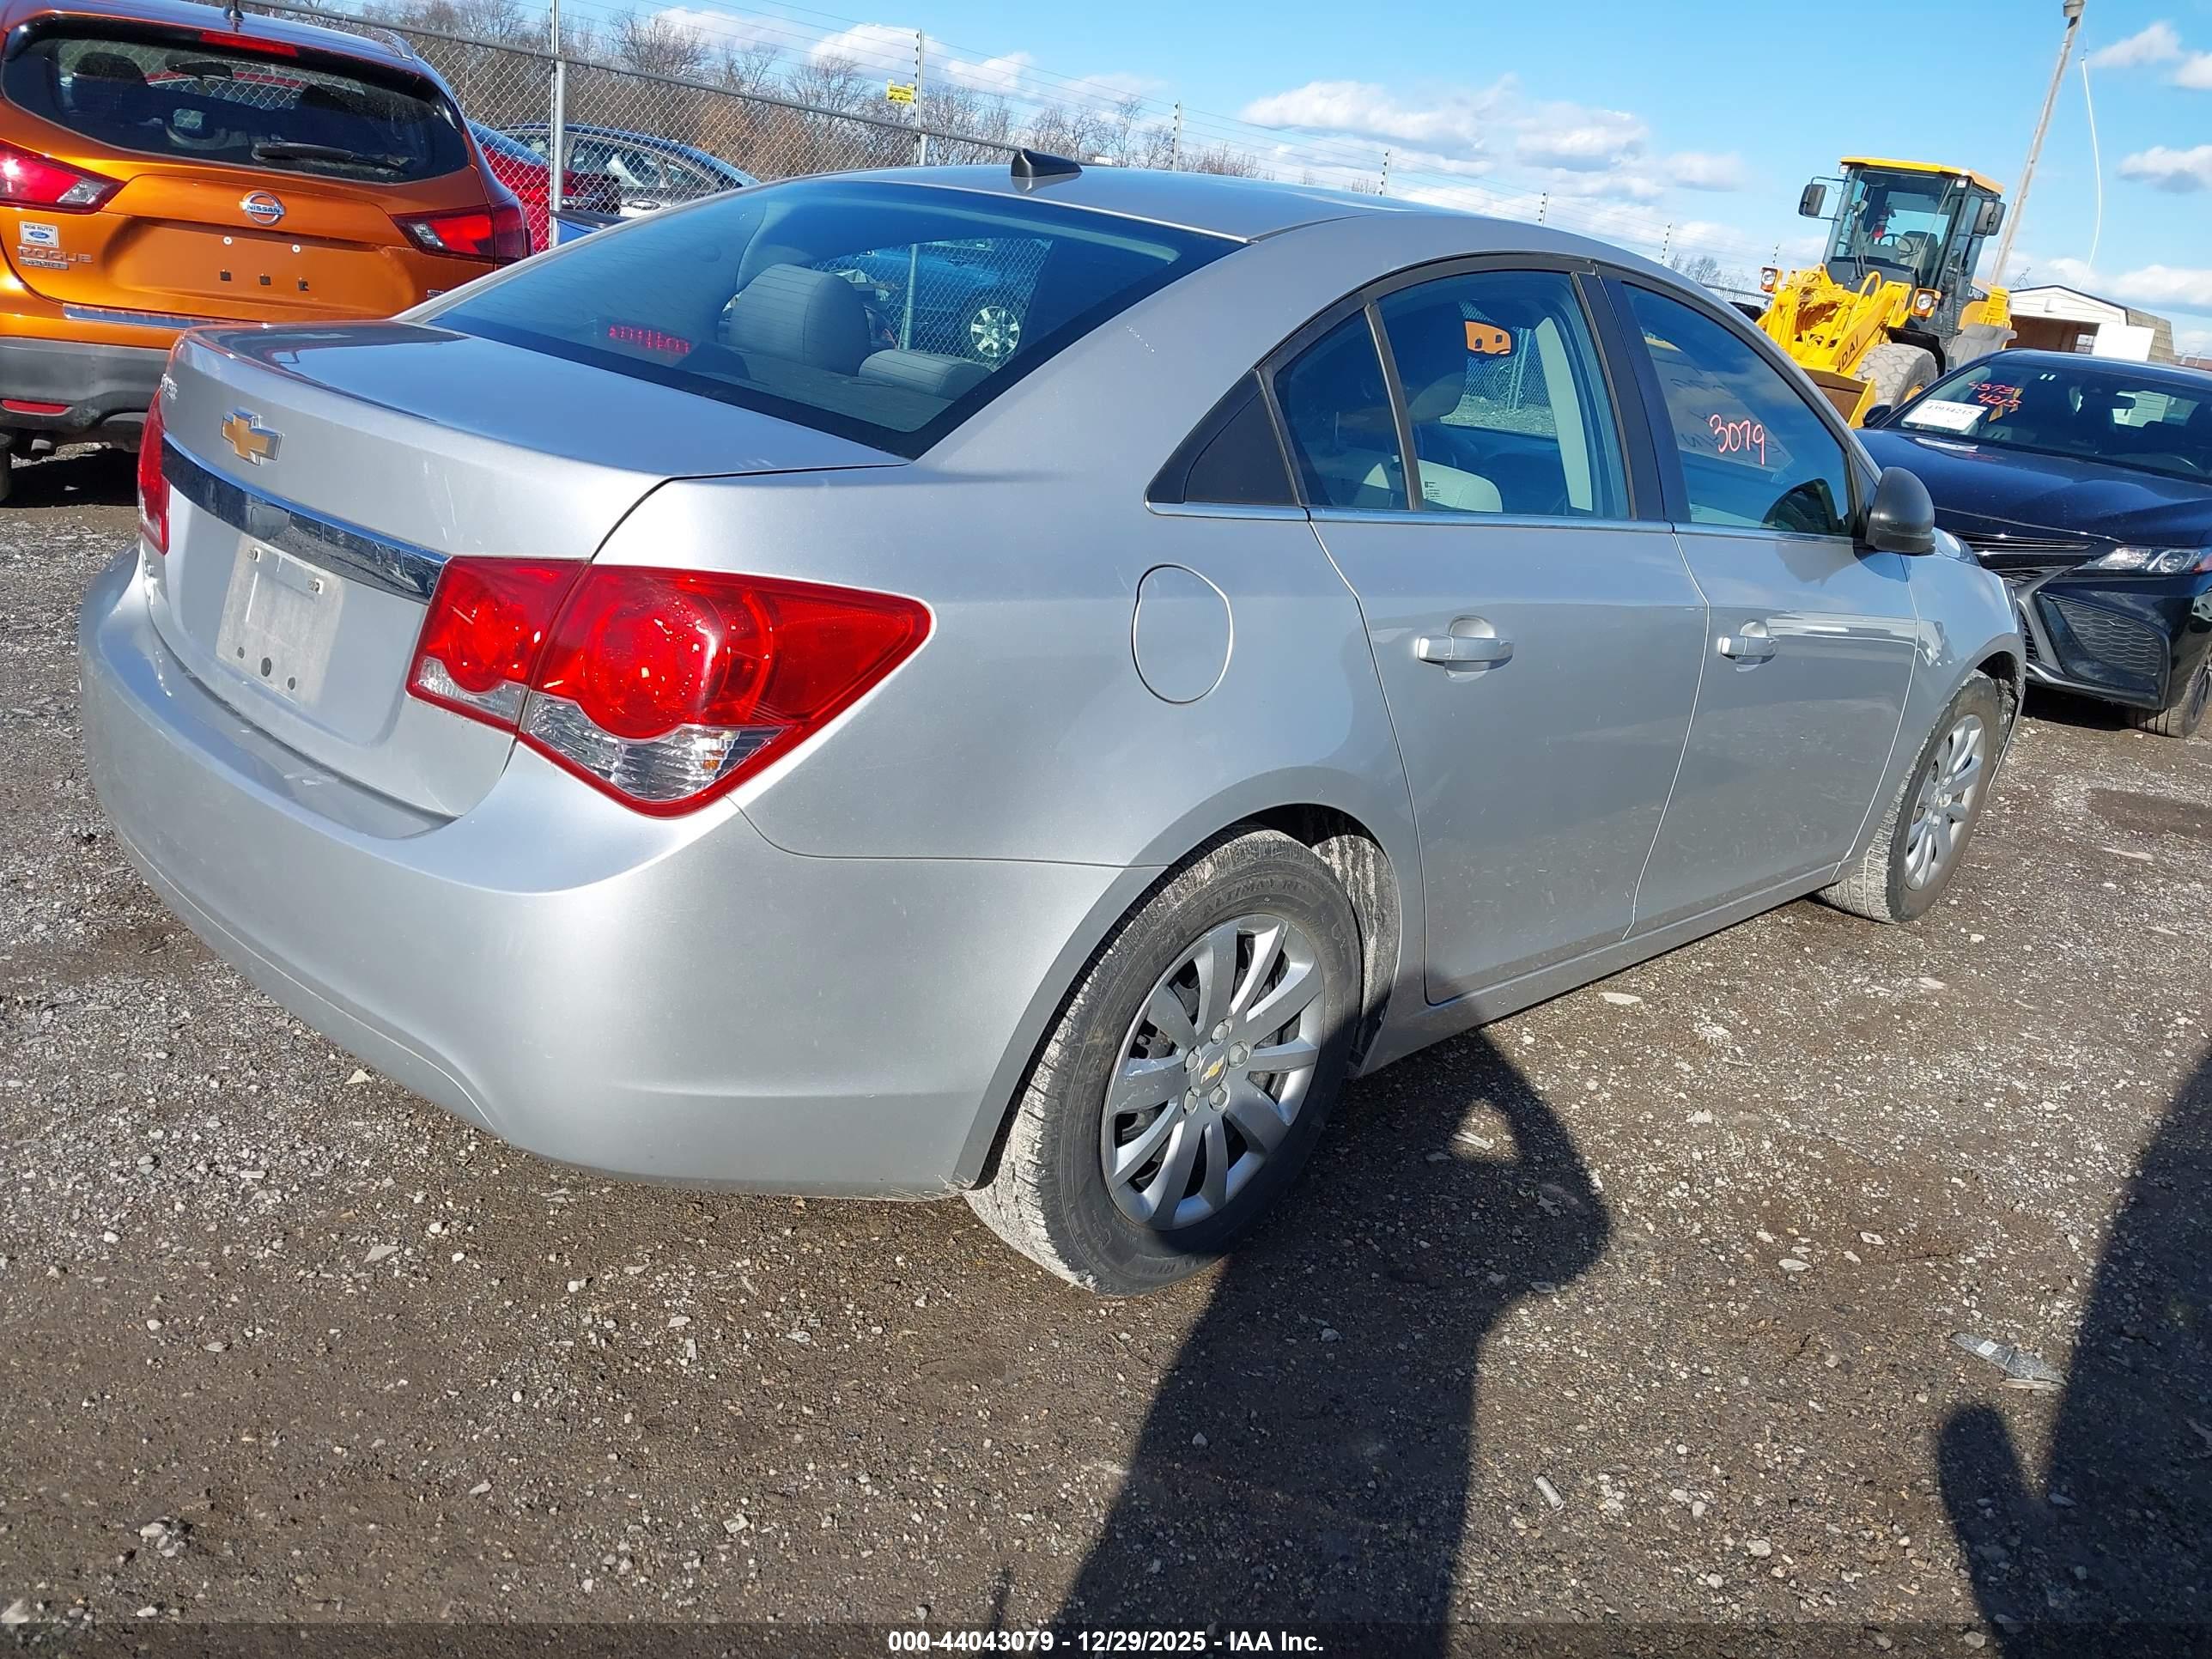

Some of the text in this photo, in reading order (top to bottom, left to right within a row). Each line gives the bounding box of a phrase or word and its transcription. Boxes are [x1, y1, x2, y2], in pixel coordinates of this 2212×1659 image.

[246, 204, 281, 214] NISSAN
[17, 246, 94, 263] ROGUE
[1978, 392, 2023, 408] 4215
[1709, 413, 1765, 465] 3079
